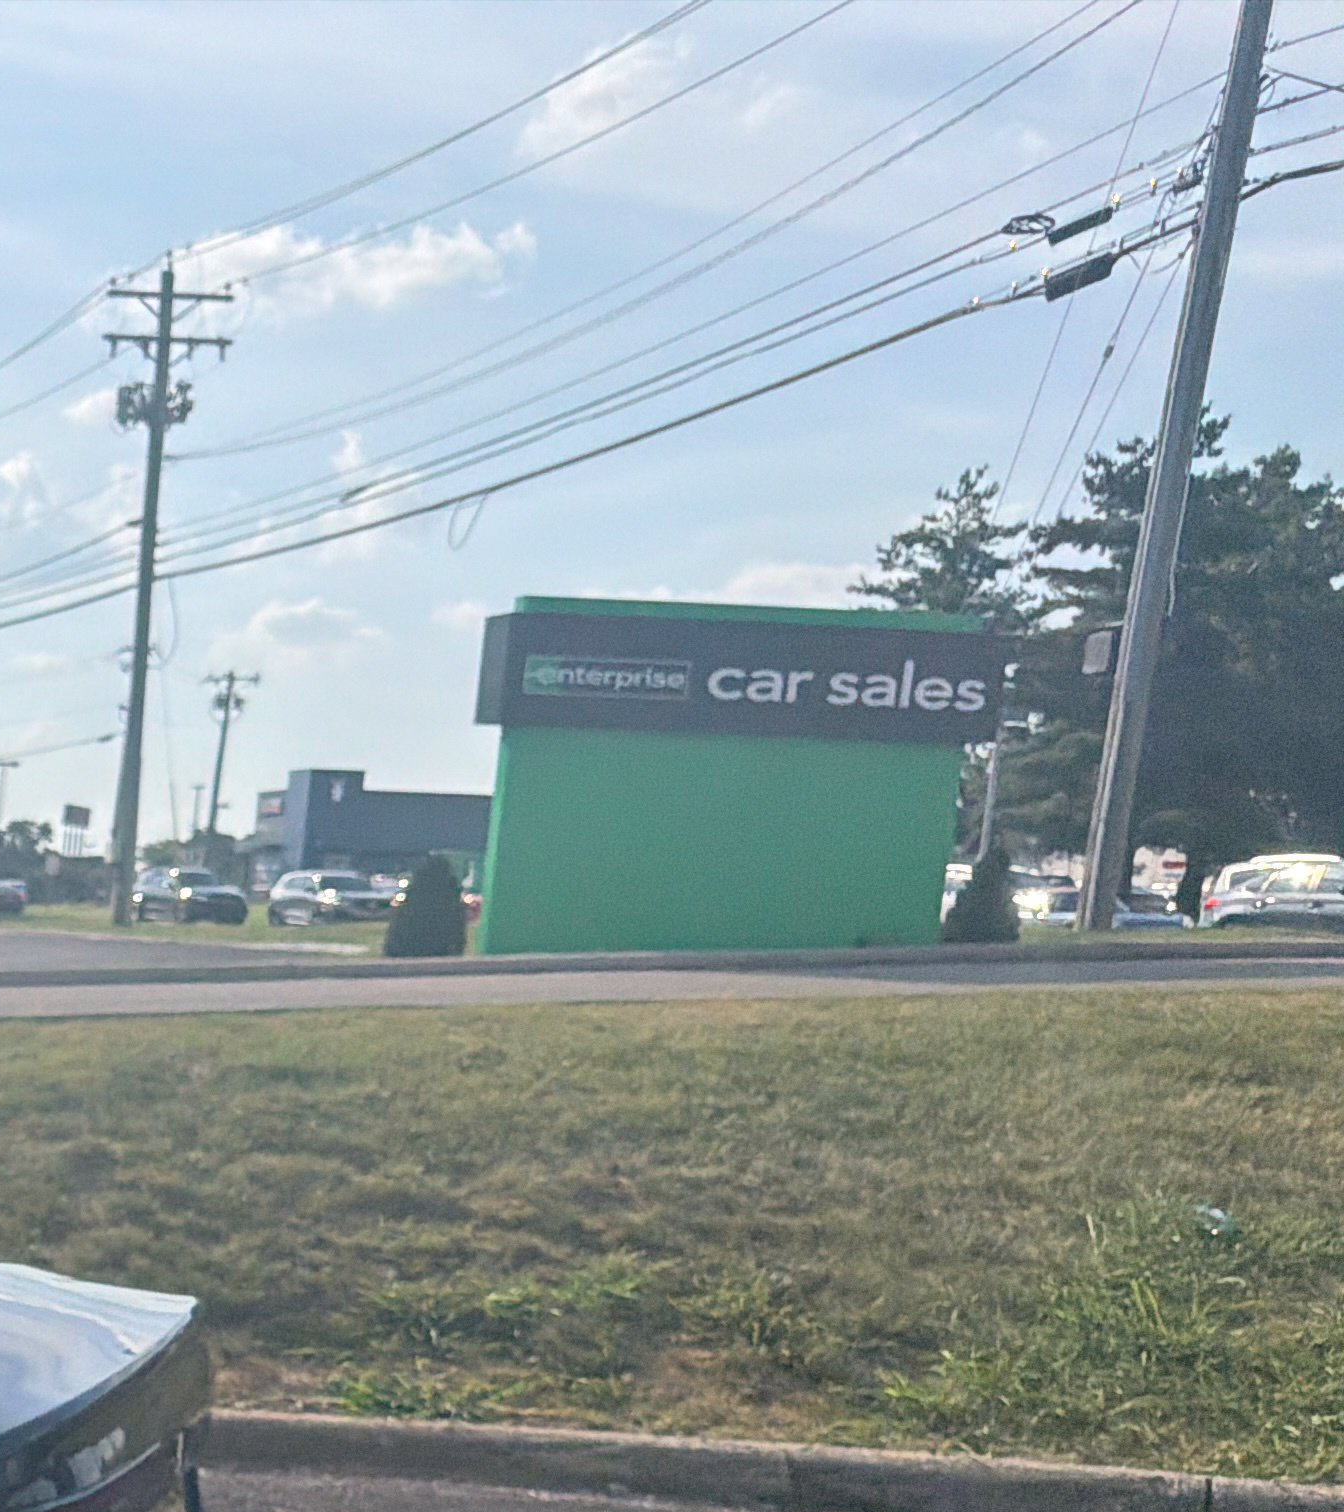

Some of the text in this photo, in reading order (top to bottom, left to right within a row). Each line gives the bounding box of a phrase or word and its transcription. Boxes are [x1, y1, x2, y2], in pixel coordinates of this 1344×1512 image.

[534, 665, 686, 690] enterprise
[707, 660, 986, 712] car sales
